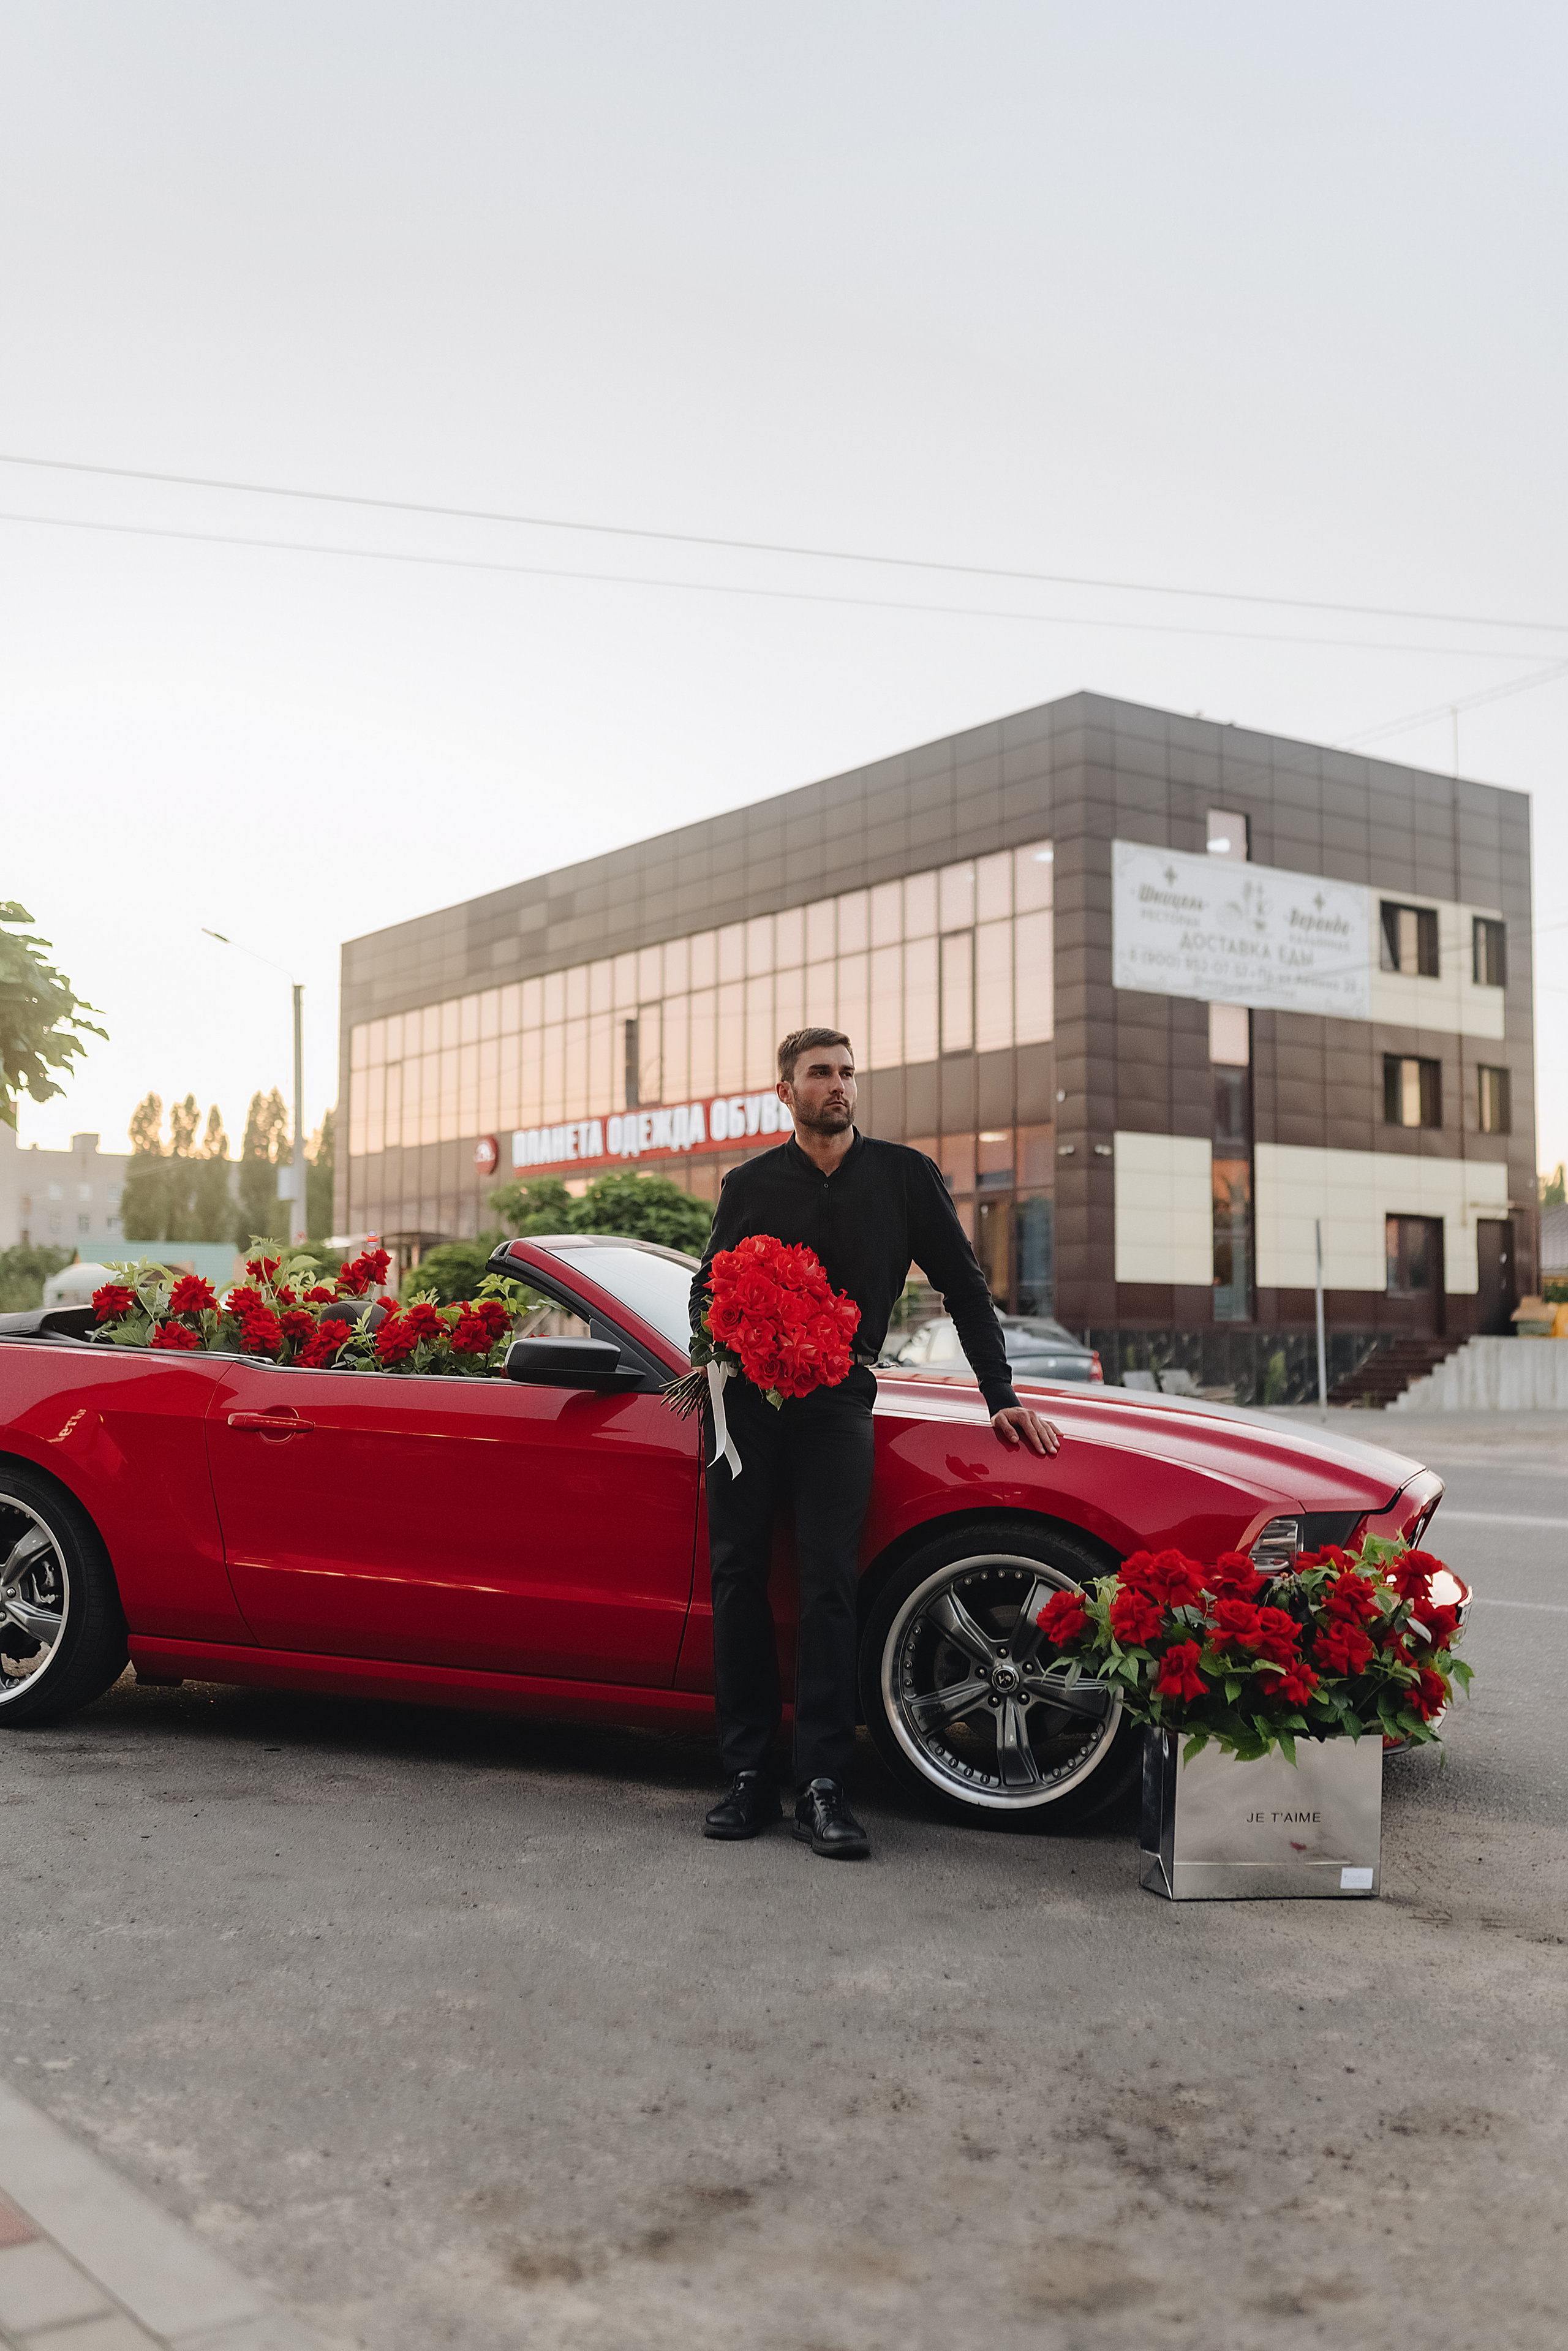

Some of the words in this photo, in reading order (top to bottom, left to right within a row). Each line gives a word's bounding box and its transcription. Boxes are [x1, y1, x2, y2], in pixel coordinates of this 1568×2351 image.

[1180, 931, 1272, 959] ДОСТАВКА
[1278, 945, 1314, 967] ЕДЫ
[513, 1120, 603, 1168] ПЛАНЕТА
[607, 1103, 706, 1158] ОДЕЖДА
[1246, 1813, 1264, 1823] JE
[1271, 1813, 1321, 1823] T'AIME
